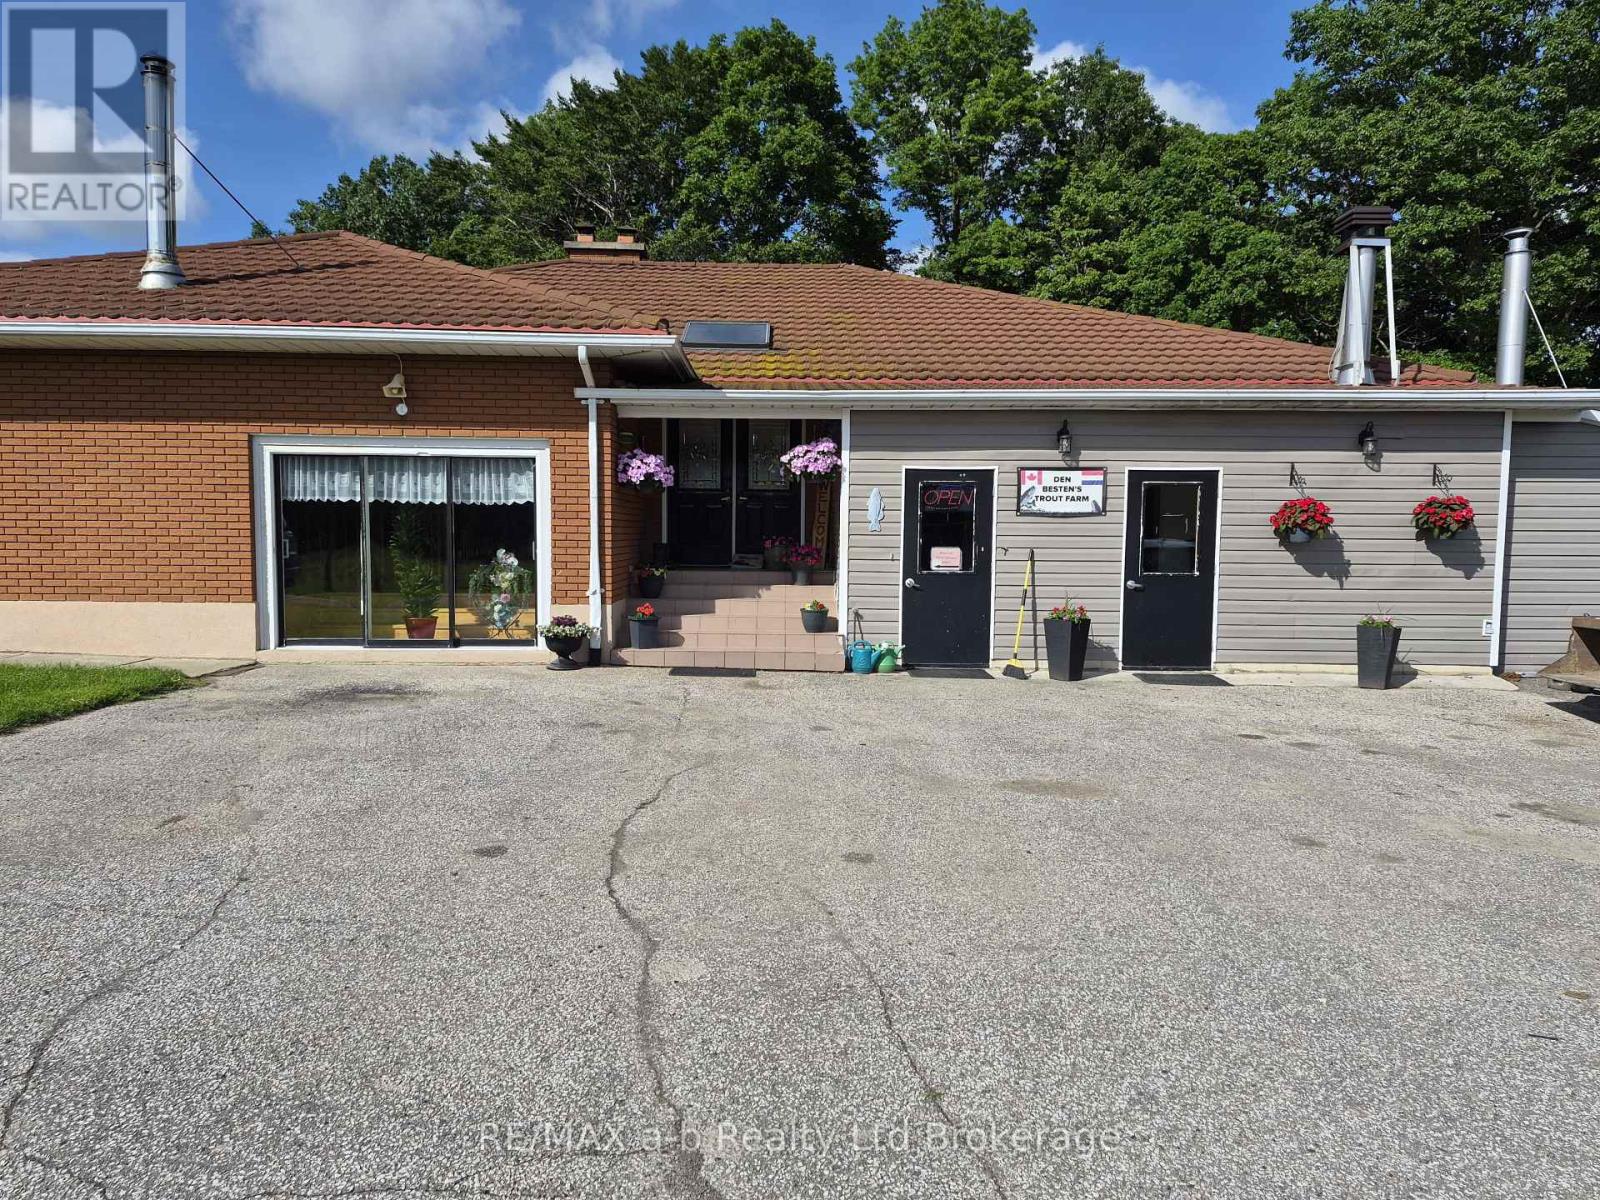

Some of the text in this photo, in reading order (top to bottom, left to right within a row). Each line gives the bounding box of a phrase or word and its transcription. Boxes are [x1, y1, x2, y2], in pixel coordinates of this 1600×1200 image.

[924, 489, 974, 506] OPEN
[1042, 485, 1082, 493] BESTEN'S
[815, 480, 830, 548] WELCOM
